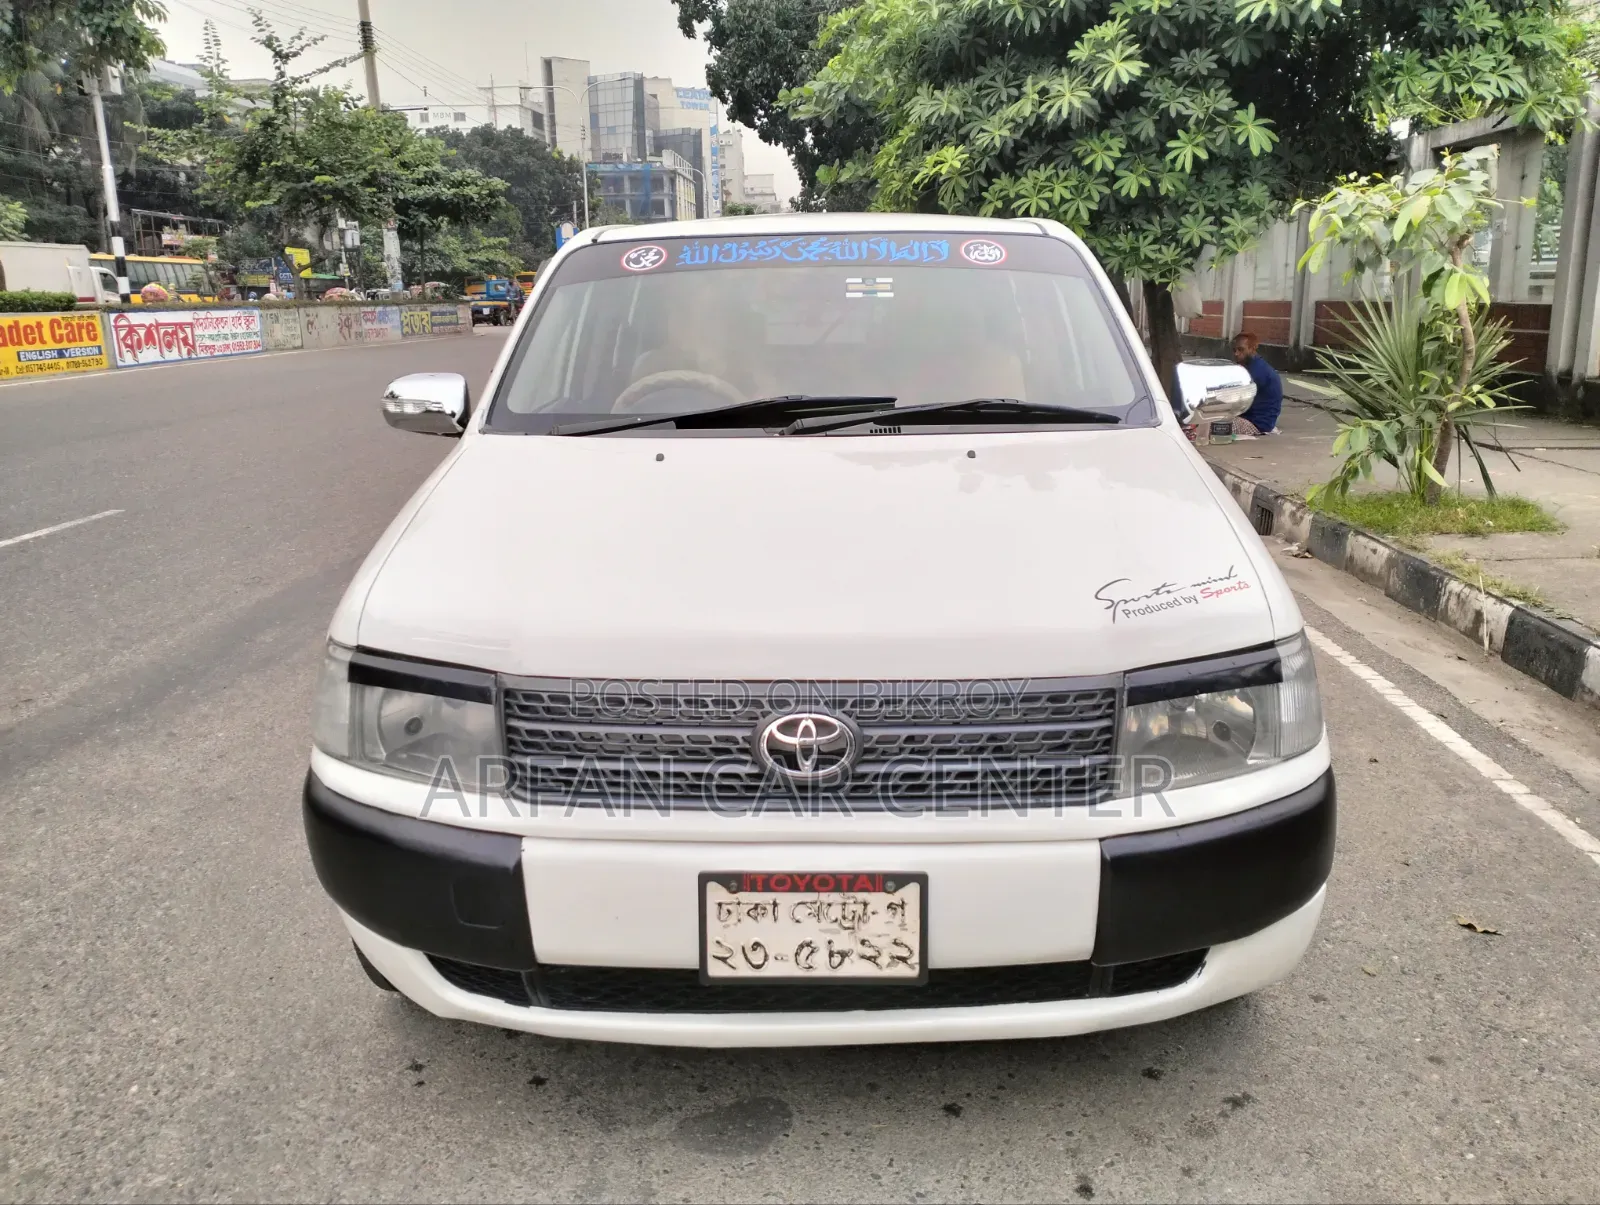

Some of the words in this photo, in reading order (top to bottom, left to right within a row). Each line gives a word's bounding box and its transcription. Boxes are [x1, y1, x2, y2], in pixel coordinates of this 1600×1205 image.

[680, 101, 709, 111] TOWER
[49, 318, 98, 344] Care
[112, 313, 198, 363] কিশলয়
[20, 351, 58, 361] ENGLISH
[63, 347, 98, 358] VERSION
[1094, 578, 1186, 624] Sports
[1190, 565, 1237, 587] mind
[1122, 599, 1182, 619] Produced
[1184, 594, 1199, 606] by
[1200, 580, 1251, 600] Sports
[751, 874, 869, 892] TOYOTA
[715, 896, 781, 924] ঢাকা
